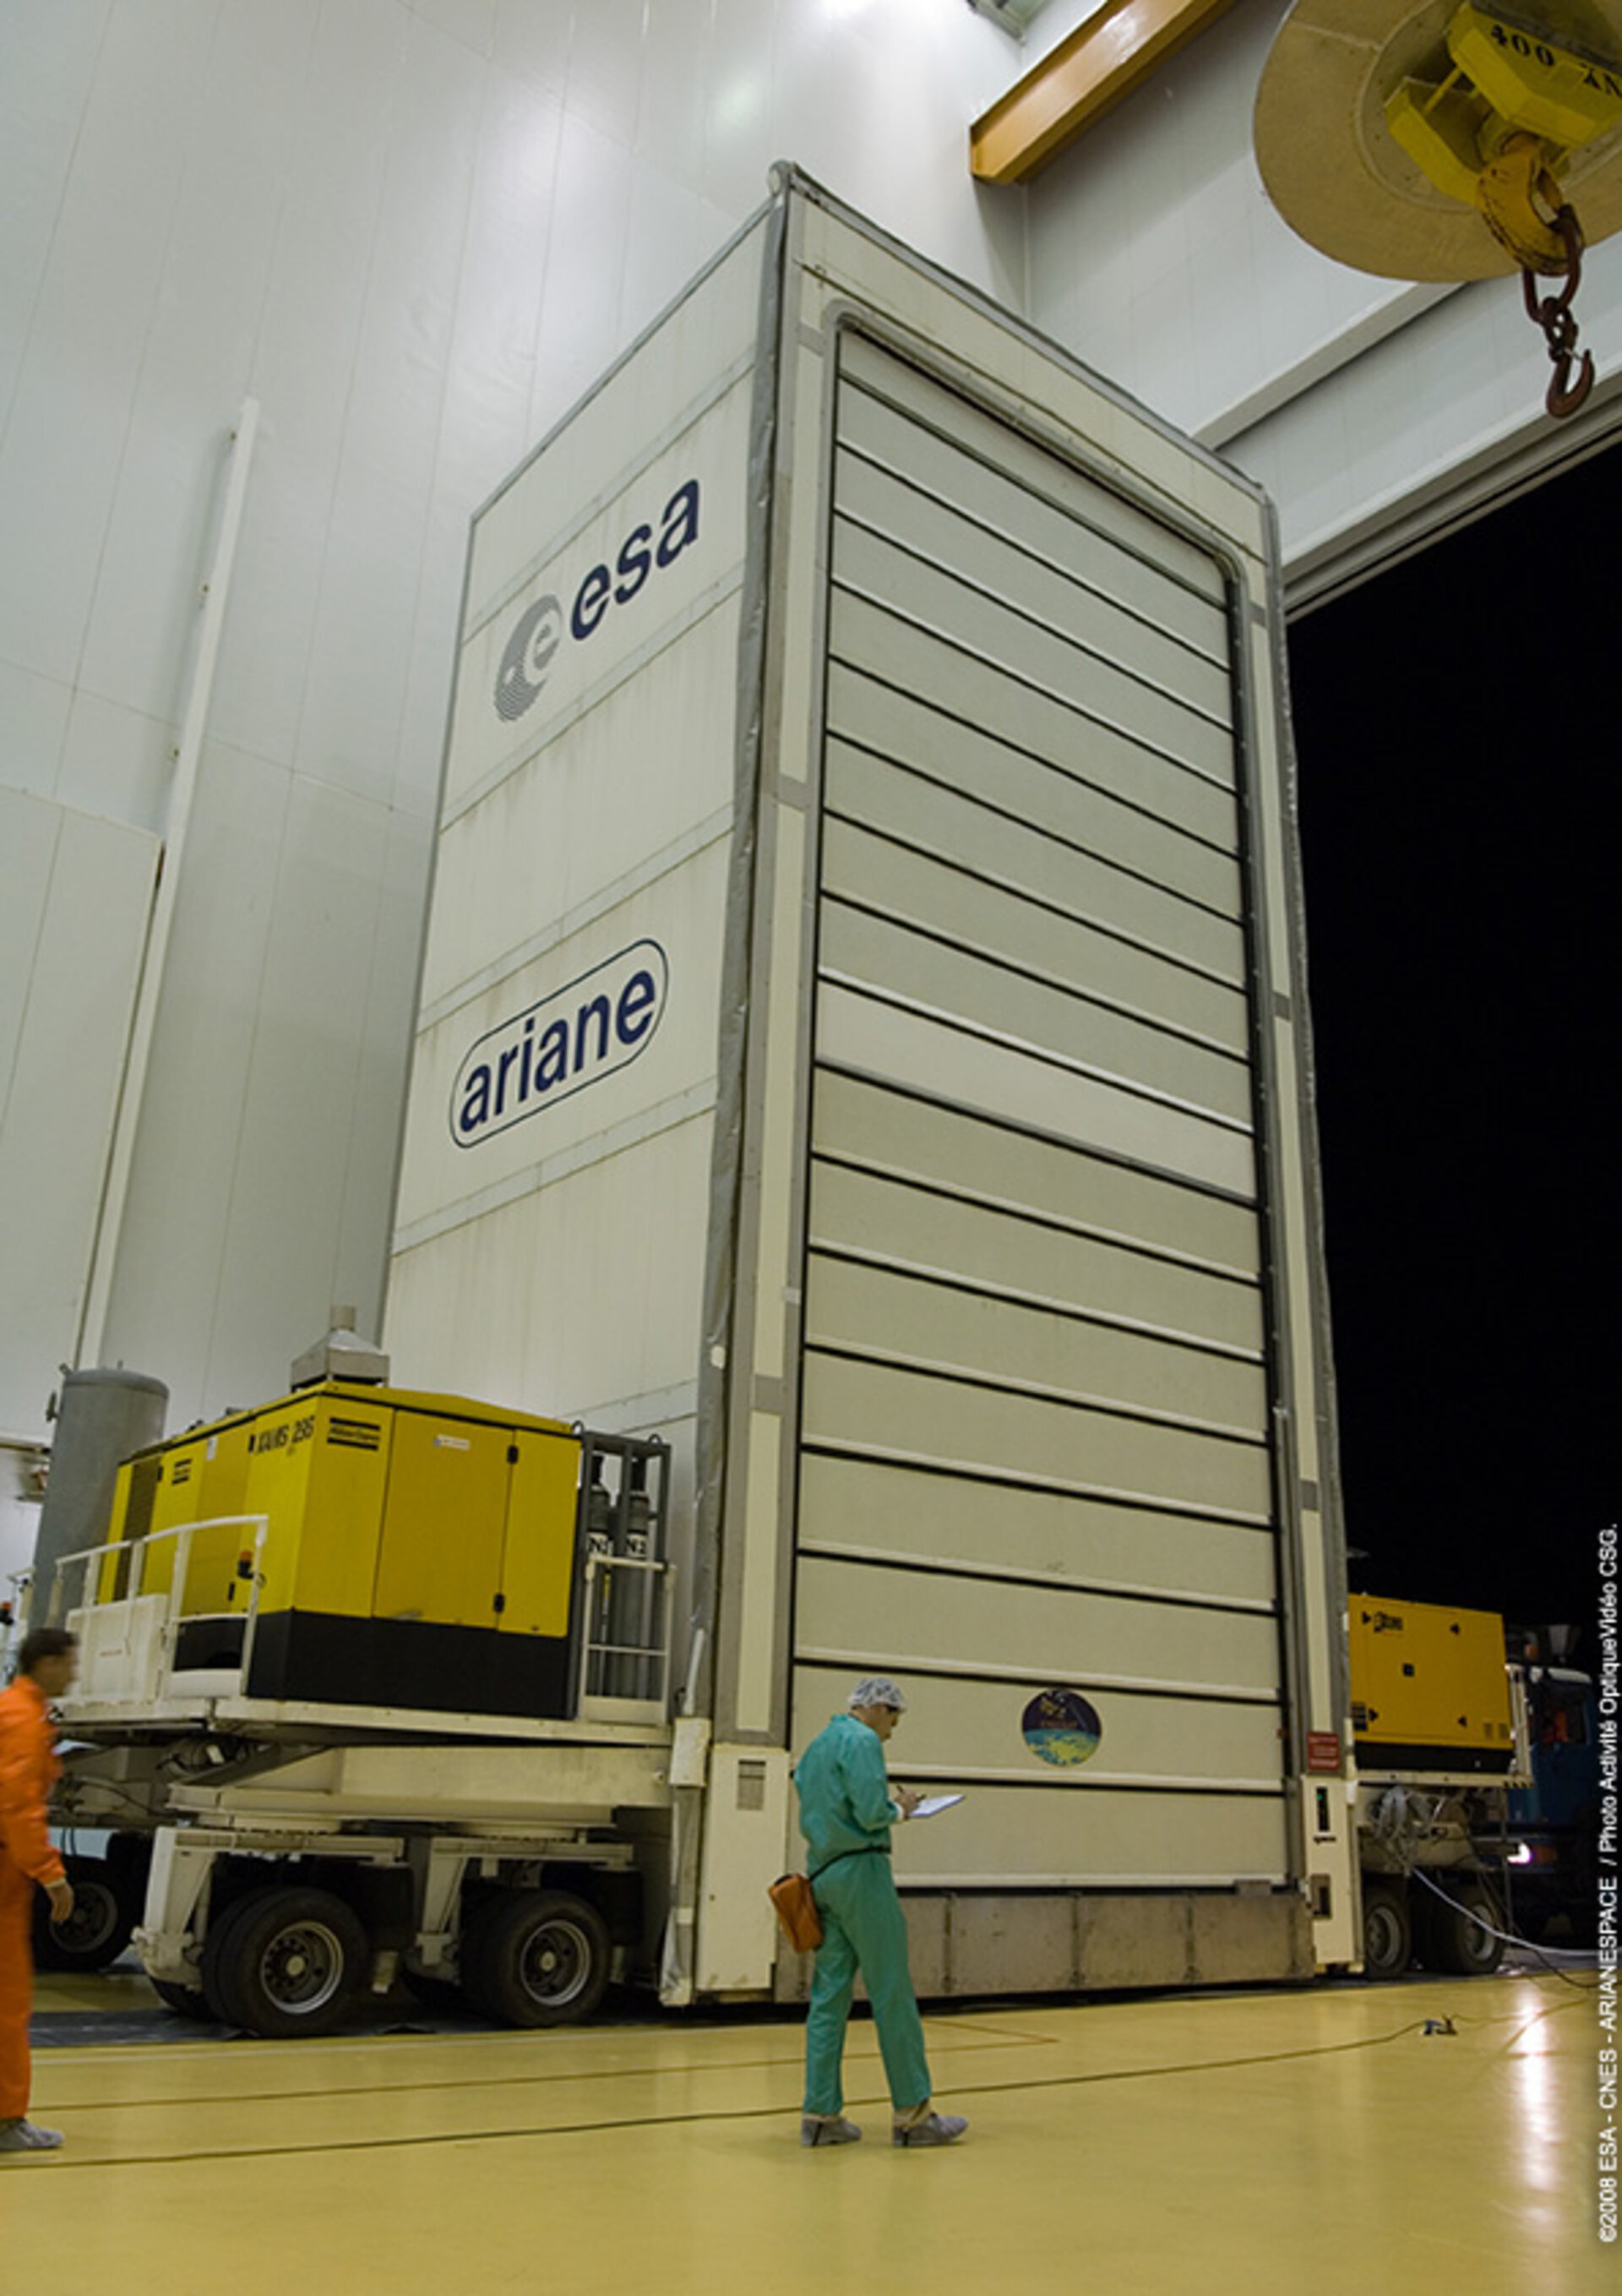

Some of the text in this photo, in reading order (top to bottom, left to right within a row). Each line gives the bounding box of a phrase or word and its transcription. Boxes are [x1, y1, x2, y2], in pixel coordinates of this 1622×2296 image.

[1490, 24, 1555, 67] 400
[571, 478, 699, 641] esa
[460, 969, 656, 1133] ariane
